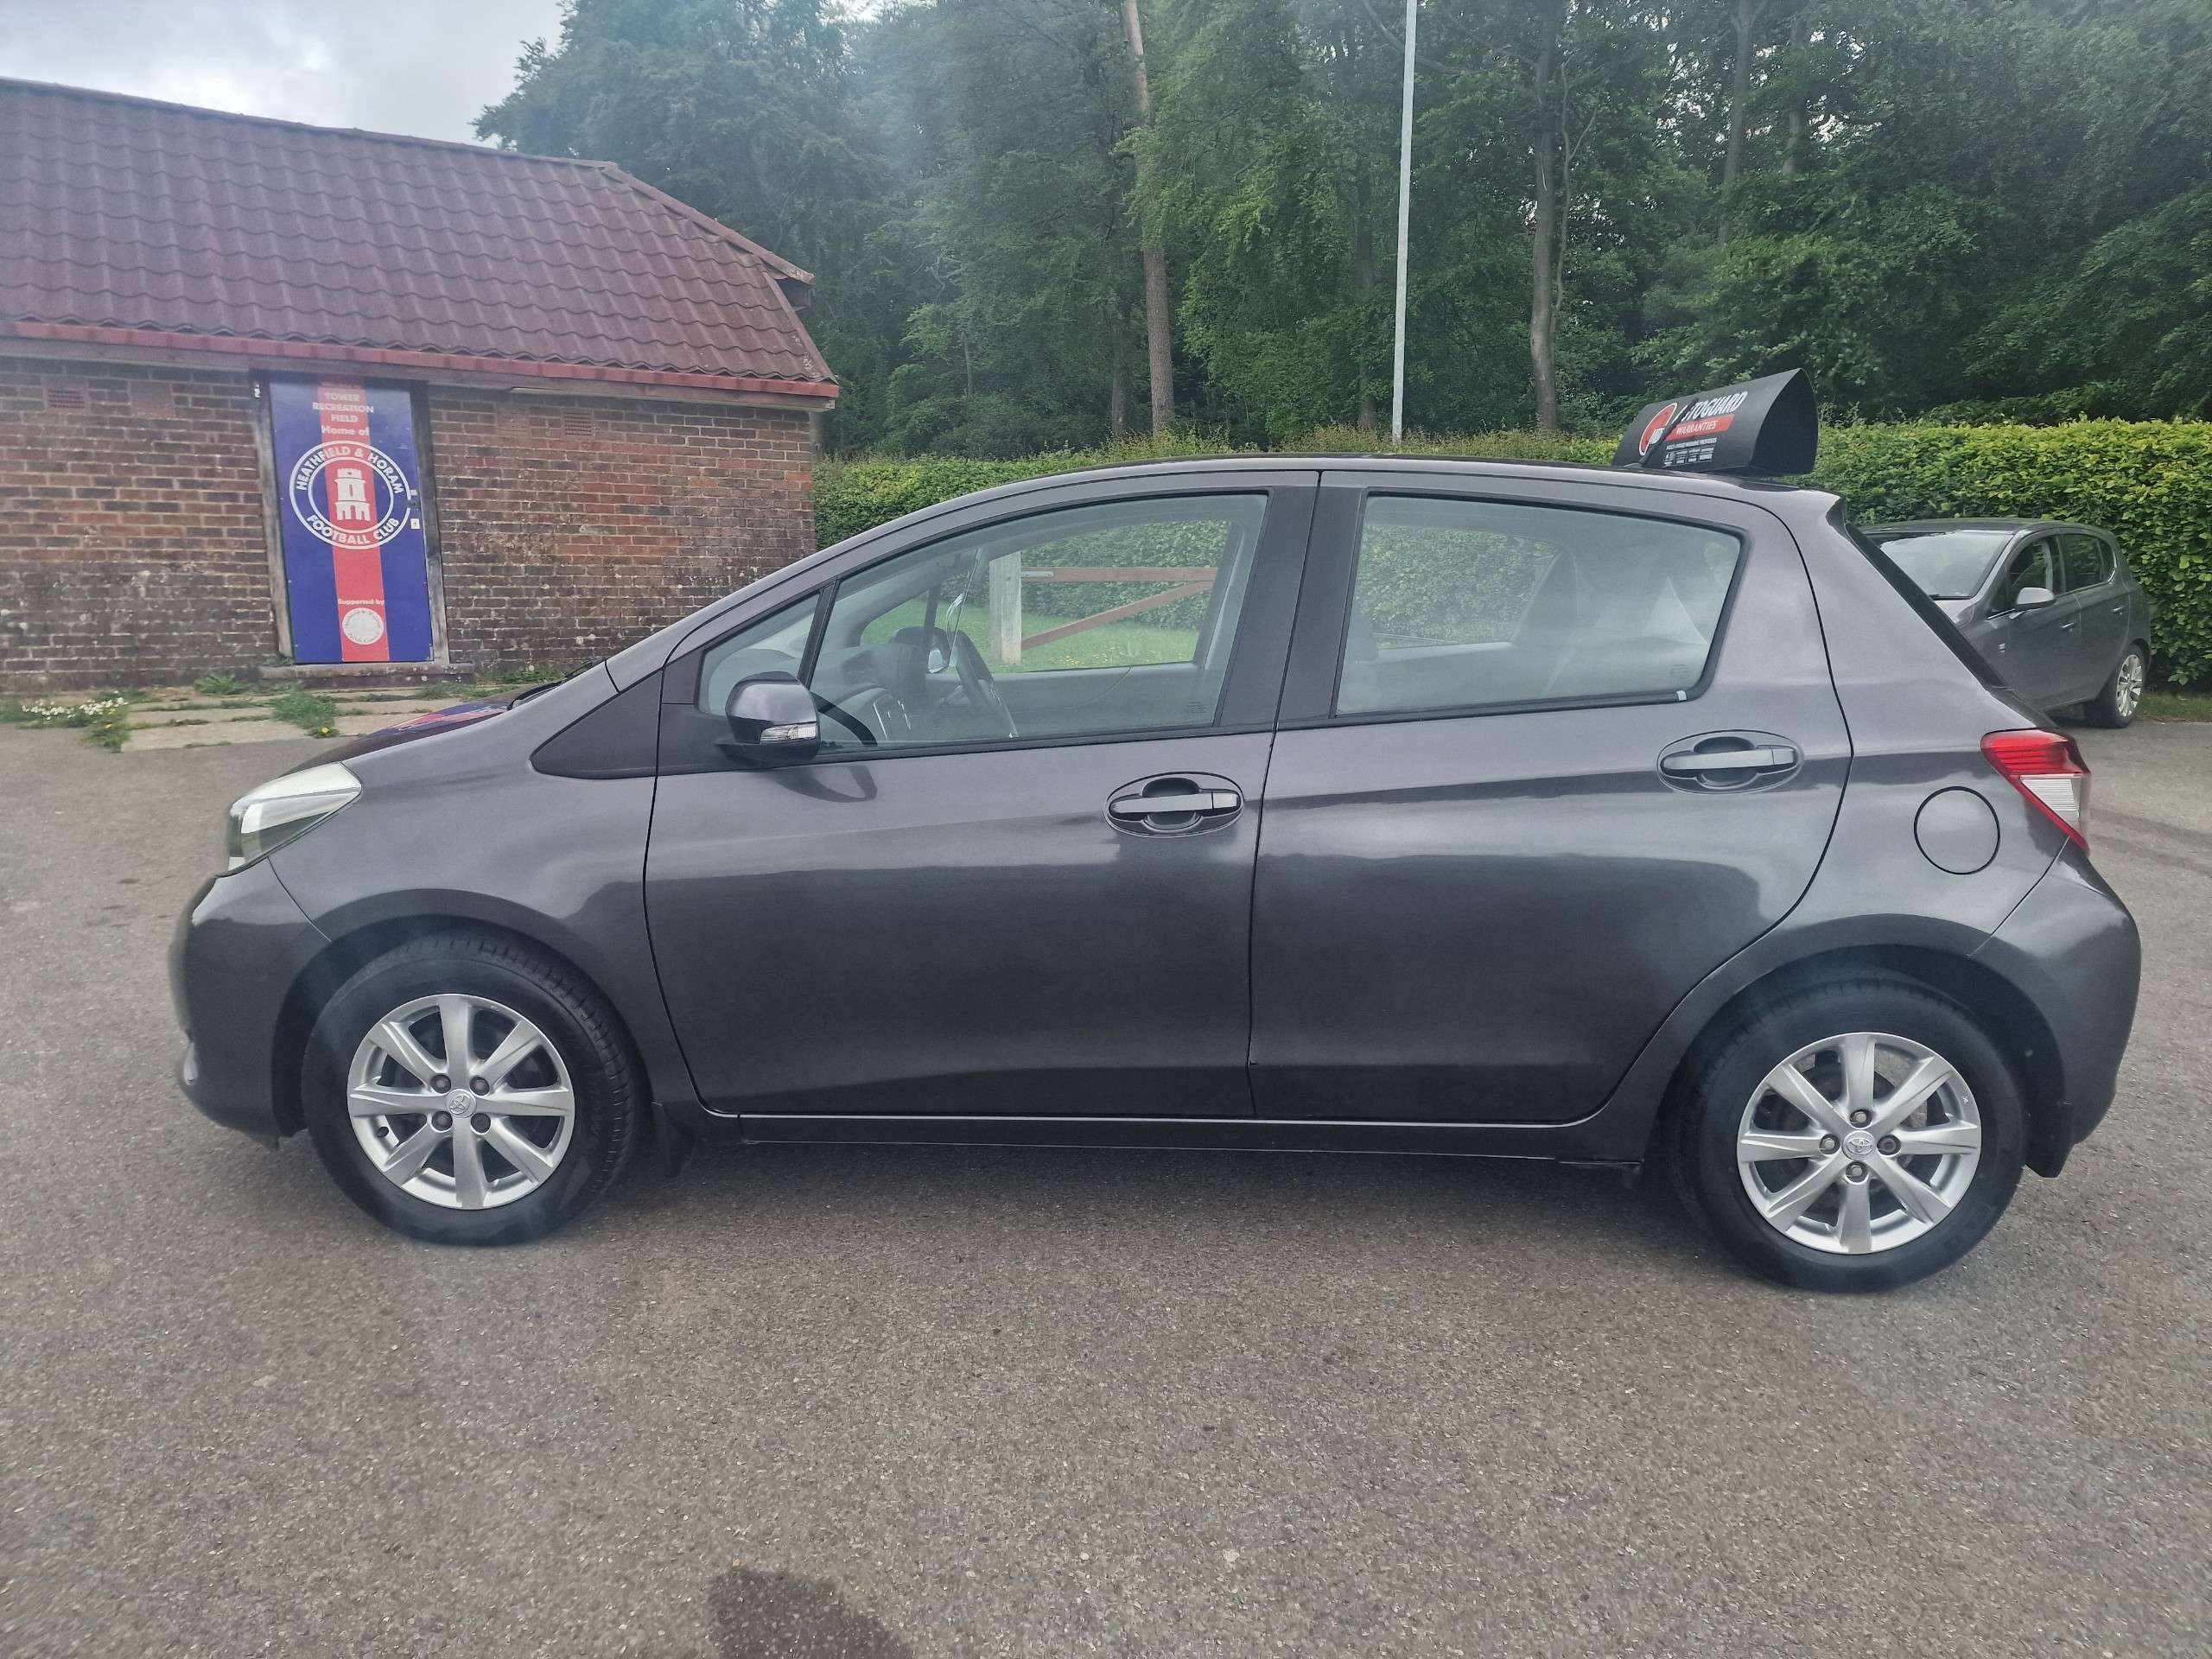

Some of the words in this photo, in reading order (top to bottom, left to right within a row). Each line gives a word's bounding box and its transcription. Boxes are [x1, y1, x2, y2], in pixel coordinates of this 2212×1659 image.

[324, 392, 360, 402] TOWER
[312, 402, 374, 413] RECREATION
[331, 414, 359, 423] FIELD
[321, 425, 355, 435] Home
[359, 427, 370, 436] of
[296, 446, 351, 491] HEATHFIELD
[354, 448, 364, 458] &
[367, 452, 404, 494] HORAM
[307, 514, 372, 545] FOOTBALL
[373, 518, 399, 540] CLUB
